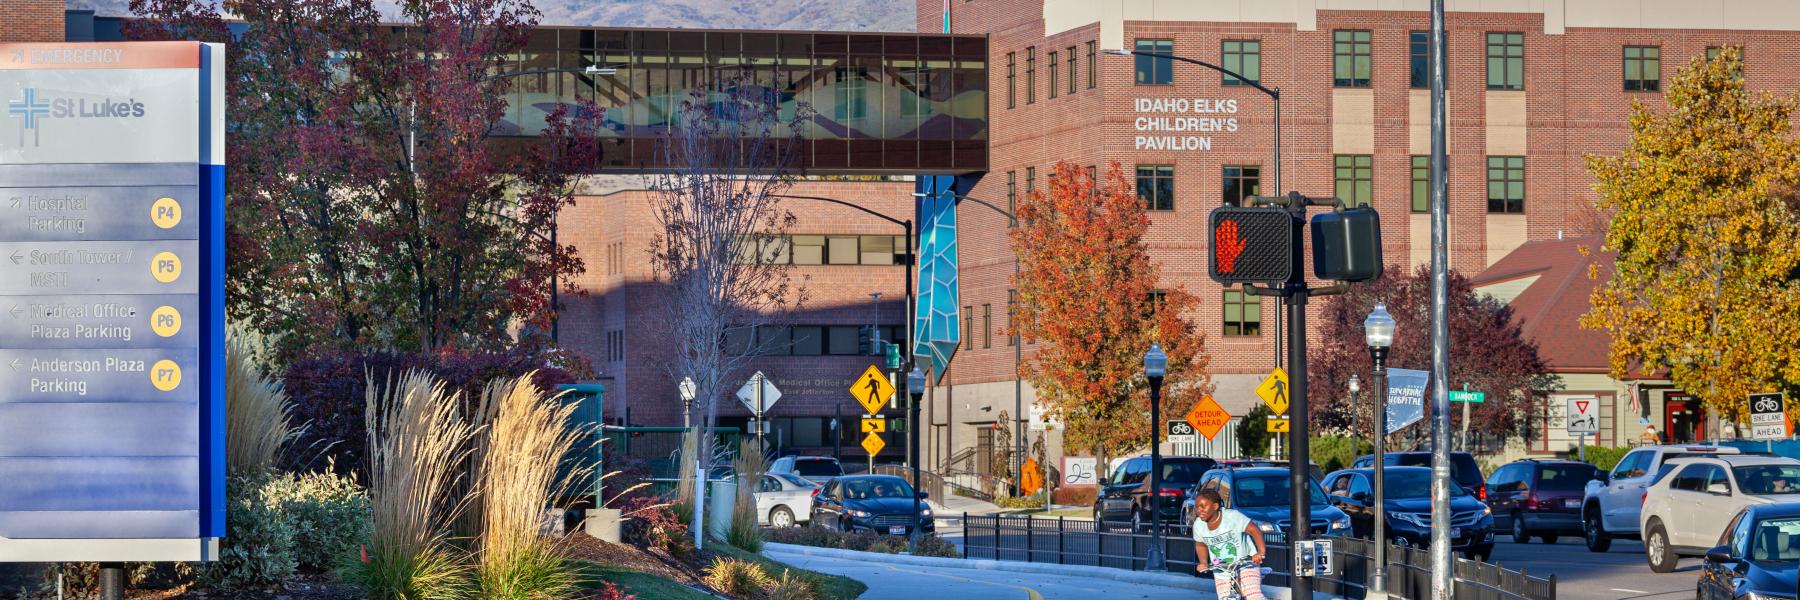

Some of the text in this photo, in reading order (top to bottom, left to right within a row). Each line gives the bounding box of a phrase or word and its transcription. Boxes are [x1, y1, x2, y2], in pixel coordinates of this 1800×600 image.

[31, 48, 122, 64] EMERGENCY
[52, 98, 145, 118] St Luke's
[1135, 99, 1237, 113] IDAHO ELKS
[1135, 117, 1238, 131] CHILDREN'S
[1135, 136, 1211, 150] PAVILION
[28, 195, 88, 213] Hospital
[157, 206, 175, 219] P4
[28, 215, 85, 233] Parking
[30, 249, 74, 265] South
[79, 249, 121, 265] Tower
[158, 260, 175, 273] P5
[30, 303, 136, 318] Medical Office
[157, 314, 174, 328] P6
[31, 324, 132, 341] Plaza Parking
[30, 358, 145, 373] Anderson Plaza
[157, 369, 174, 382] P7
[31, 379, 87, 396] Parking
[778, 379, 811, 387] Medical
[1757, 427, 1782, 436] AHEAD
